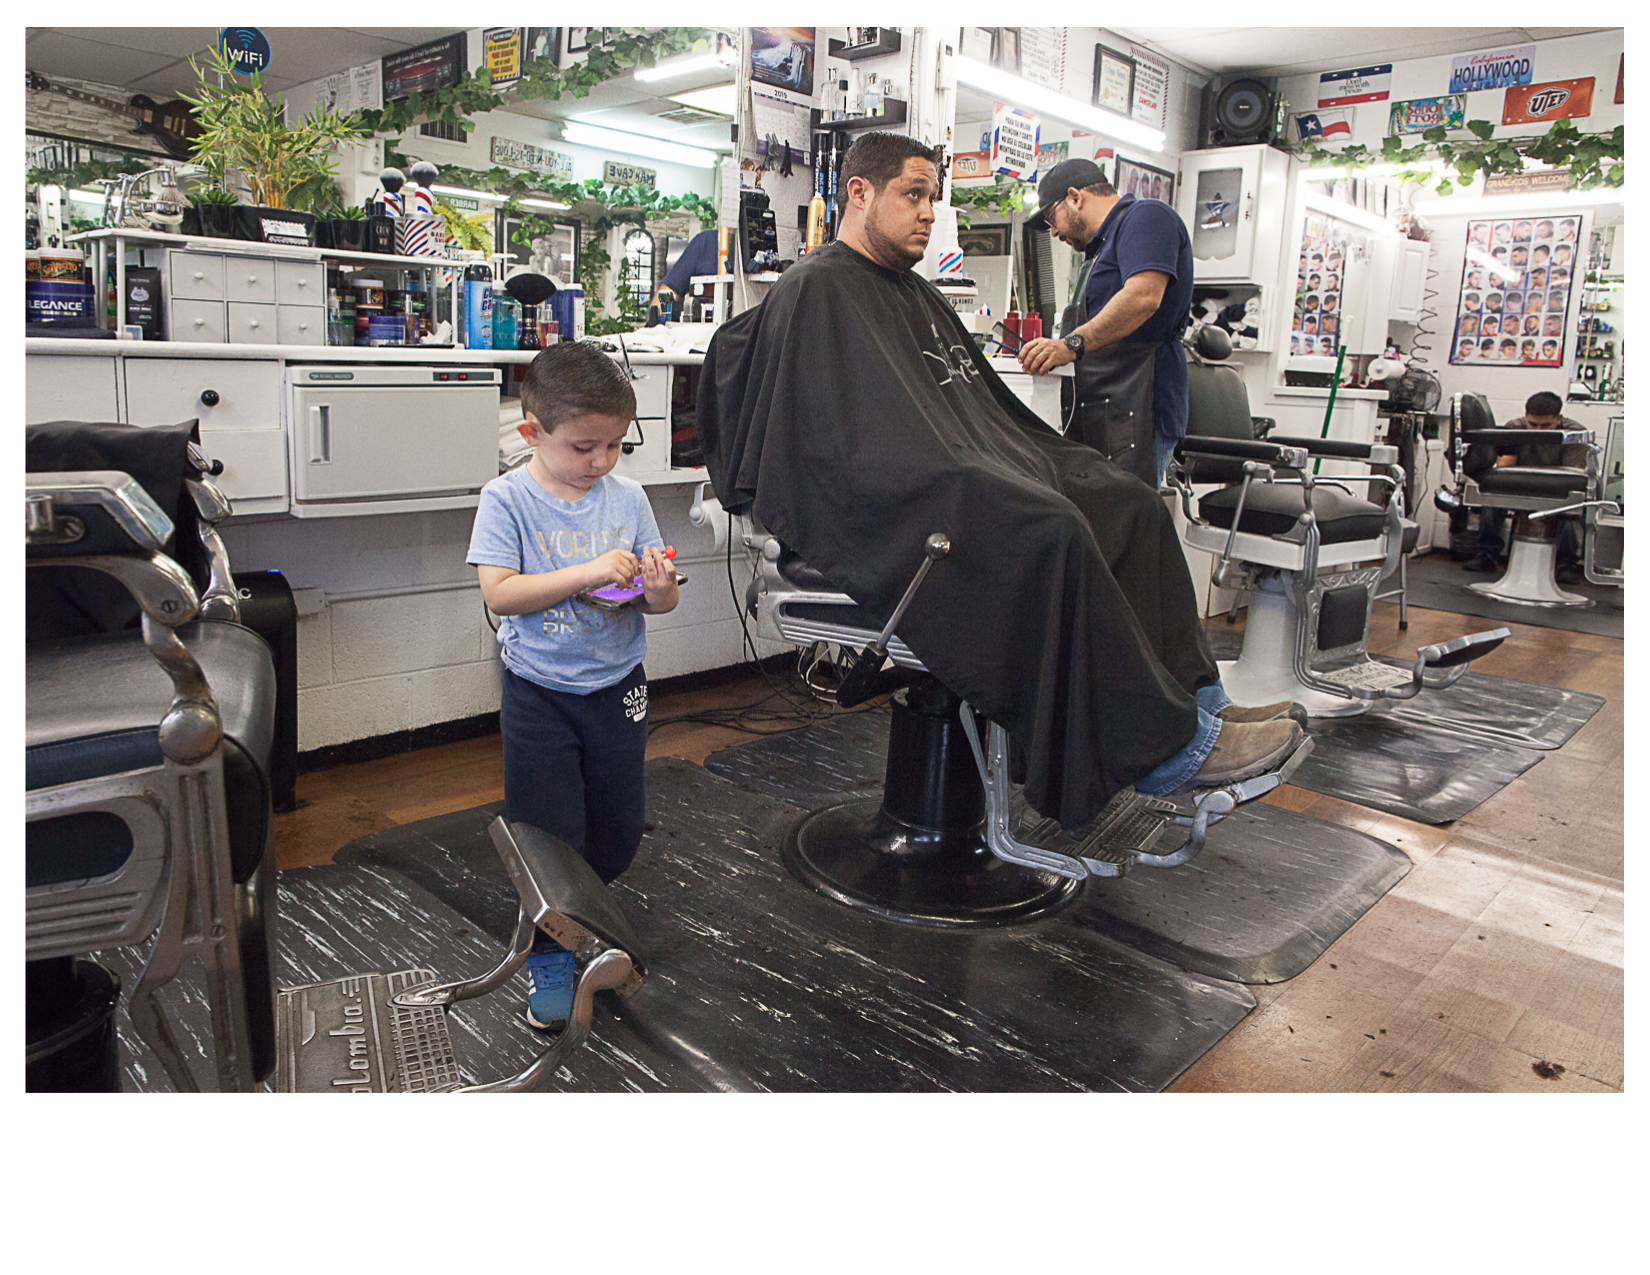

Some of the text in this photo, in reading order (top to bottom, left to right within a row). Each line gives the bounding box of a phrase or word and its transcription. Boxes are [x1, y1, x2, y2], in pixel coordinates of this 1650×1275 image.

[227, 47, 263, 66] WiFi
[1470, 53, 1515, 65] California
[1454, 58, 1530, 85] HOLLYWOOD
[1355, 80, 1370, 88] with
[774, 89, 788, 99] 2019
[1530, 90, 1566, 113] UTEP
[1407, 101, 1445, 115] Señor
[1005, 116, 1013, 125] PARA
[1020, 120, 1031, 131] MEJOR
[1002, 125, 1018, 136] ATENCION
[1022, 130, 1033, 142] CORTE
[999, 144, 1016, 156] MIENTRAS
[1016, 149, 1021, 157] SE
[1025, 152, 1033, 161] ESTE
[1017, 139, 1032, 151] CELULAR
[1005, 156, 1025, 169] ATENDIENDO
[1486, 174, 1570, 189] GRANDKIDS WELCOME
[28, 300, 83, 310] LEGANCE
[542, 607, 625, 635] BROTHE
[622, 685, 648, 707] STATE
